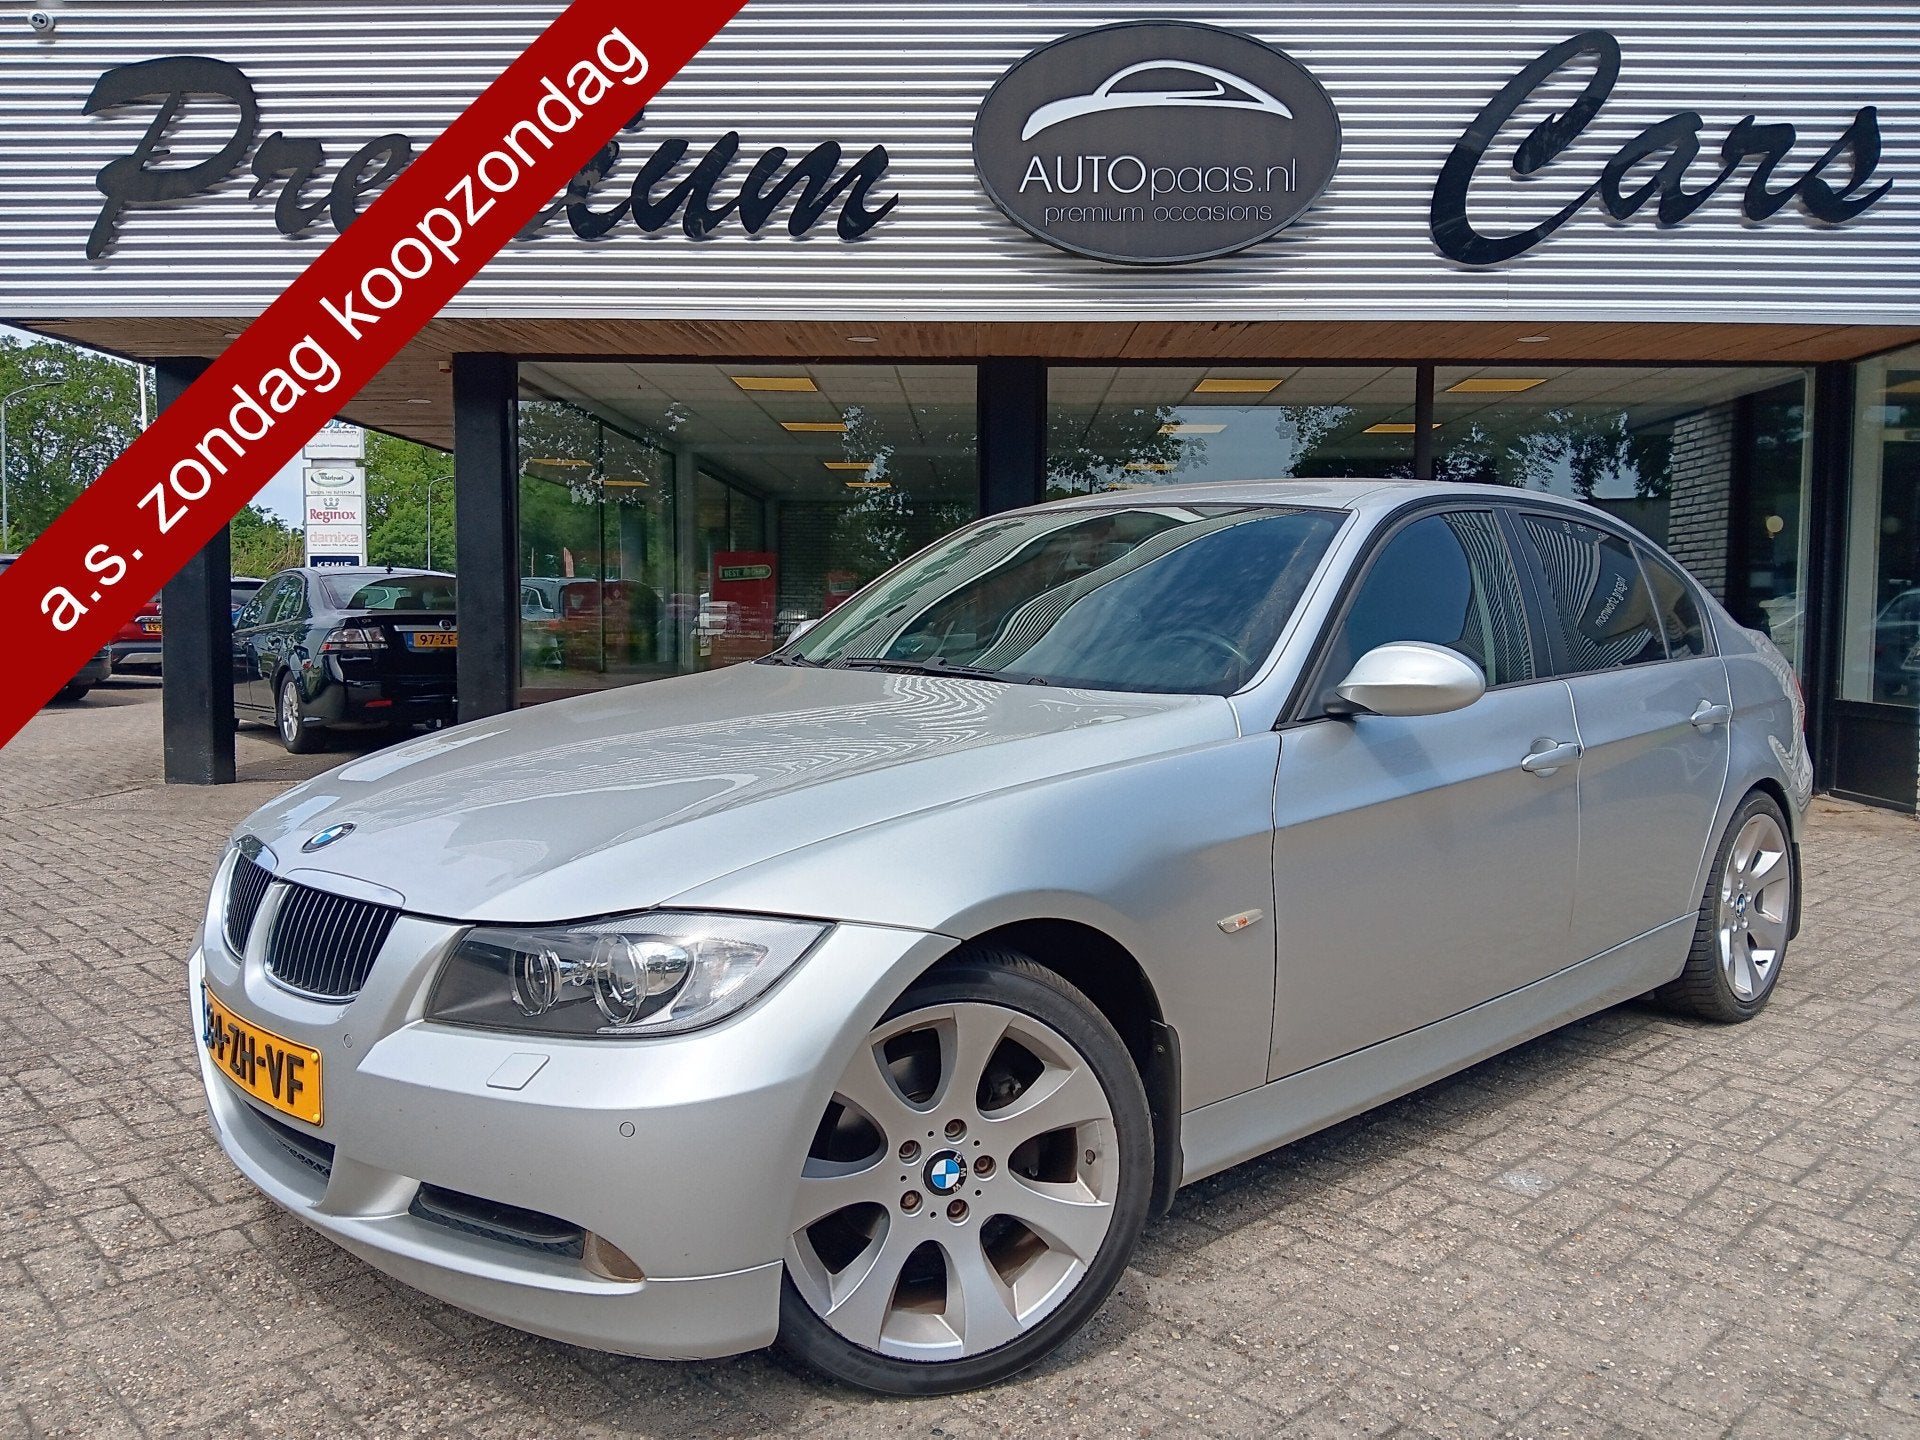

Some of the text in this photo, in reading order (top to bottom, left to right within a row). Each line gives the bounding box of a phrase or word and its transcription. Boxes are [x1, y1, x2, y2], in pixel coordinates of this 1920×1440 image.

[82, 28, 1893, 265] Preium Cars
[1018, 155, 1297, 200] AUTOpaas.nl
[1044, 201, 1272, 226] premium occasions
[310, 508, 357, 523] Reginox
[310, 531, 359, 543] damixa
